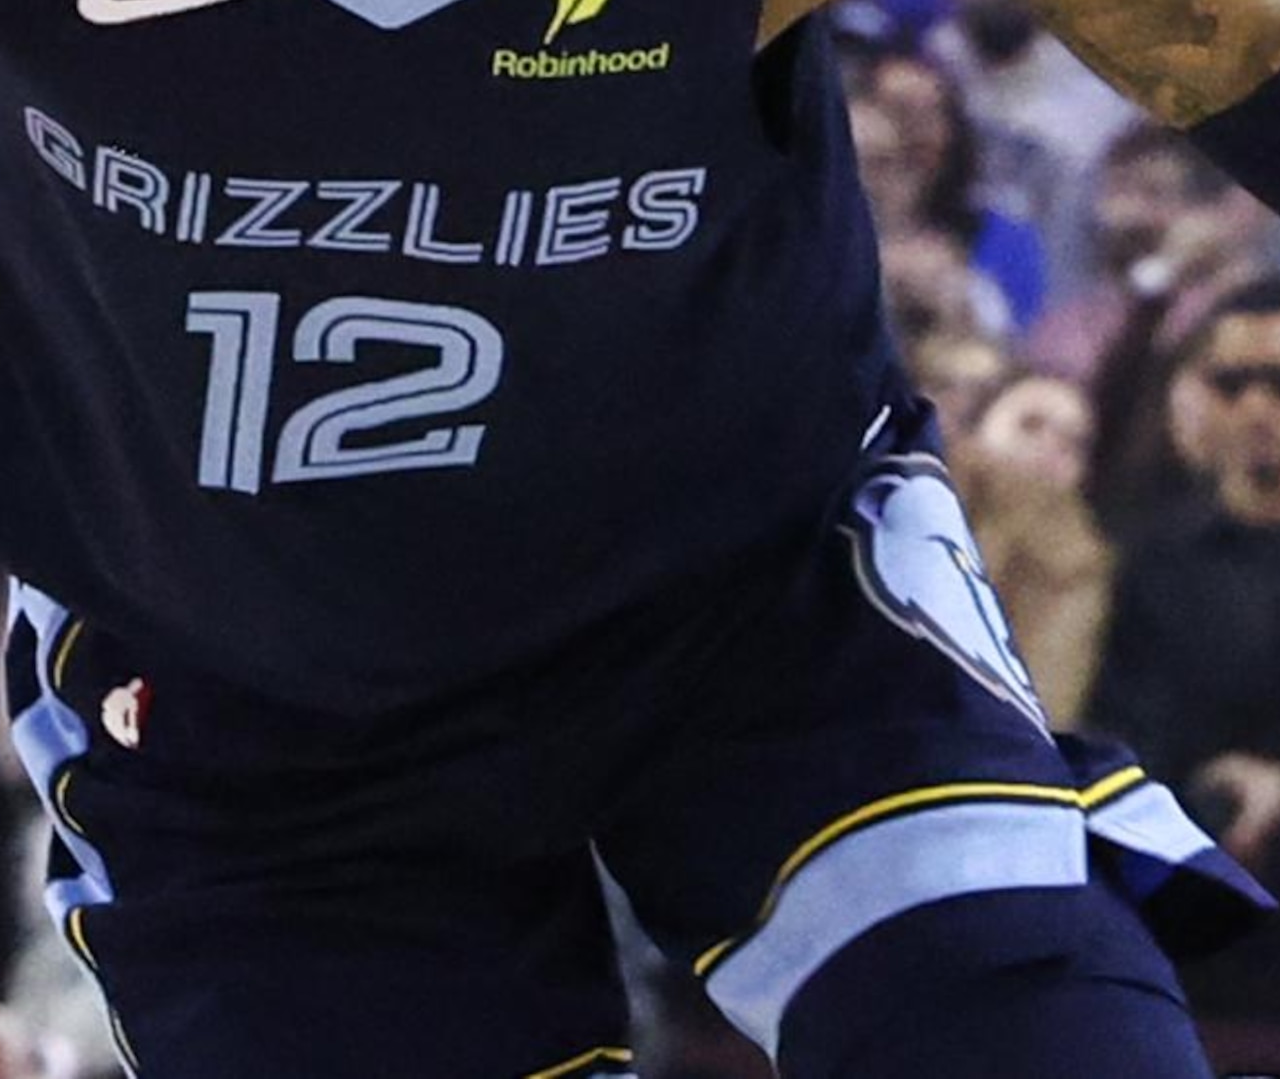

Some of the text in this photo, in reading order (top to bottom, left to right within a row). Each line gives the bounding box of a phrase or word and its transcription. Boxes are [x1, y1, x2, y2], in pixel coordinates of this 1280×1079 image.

[492, 42, 670, 80] Robinhood
[23, 105, 707, 268] GRIZZLIES
[185, 290, 505, 495] 12
